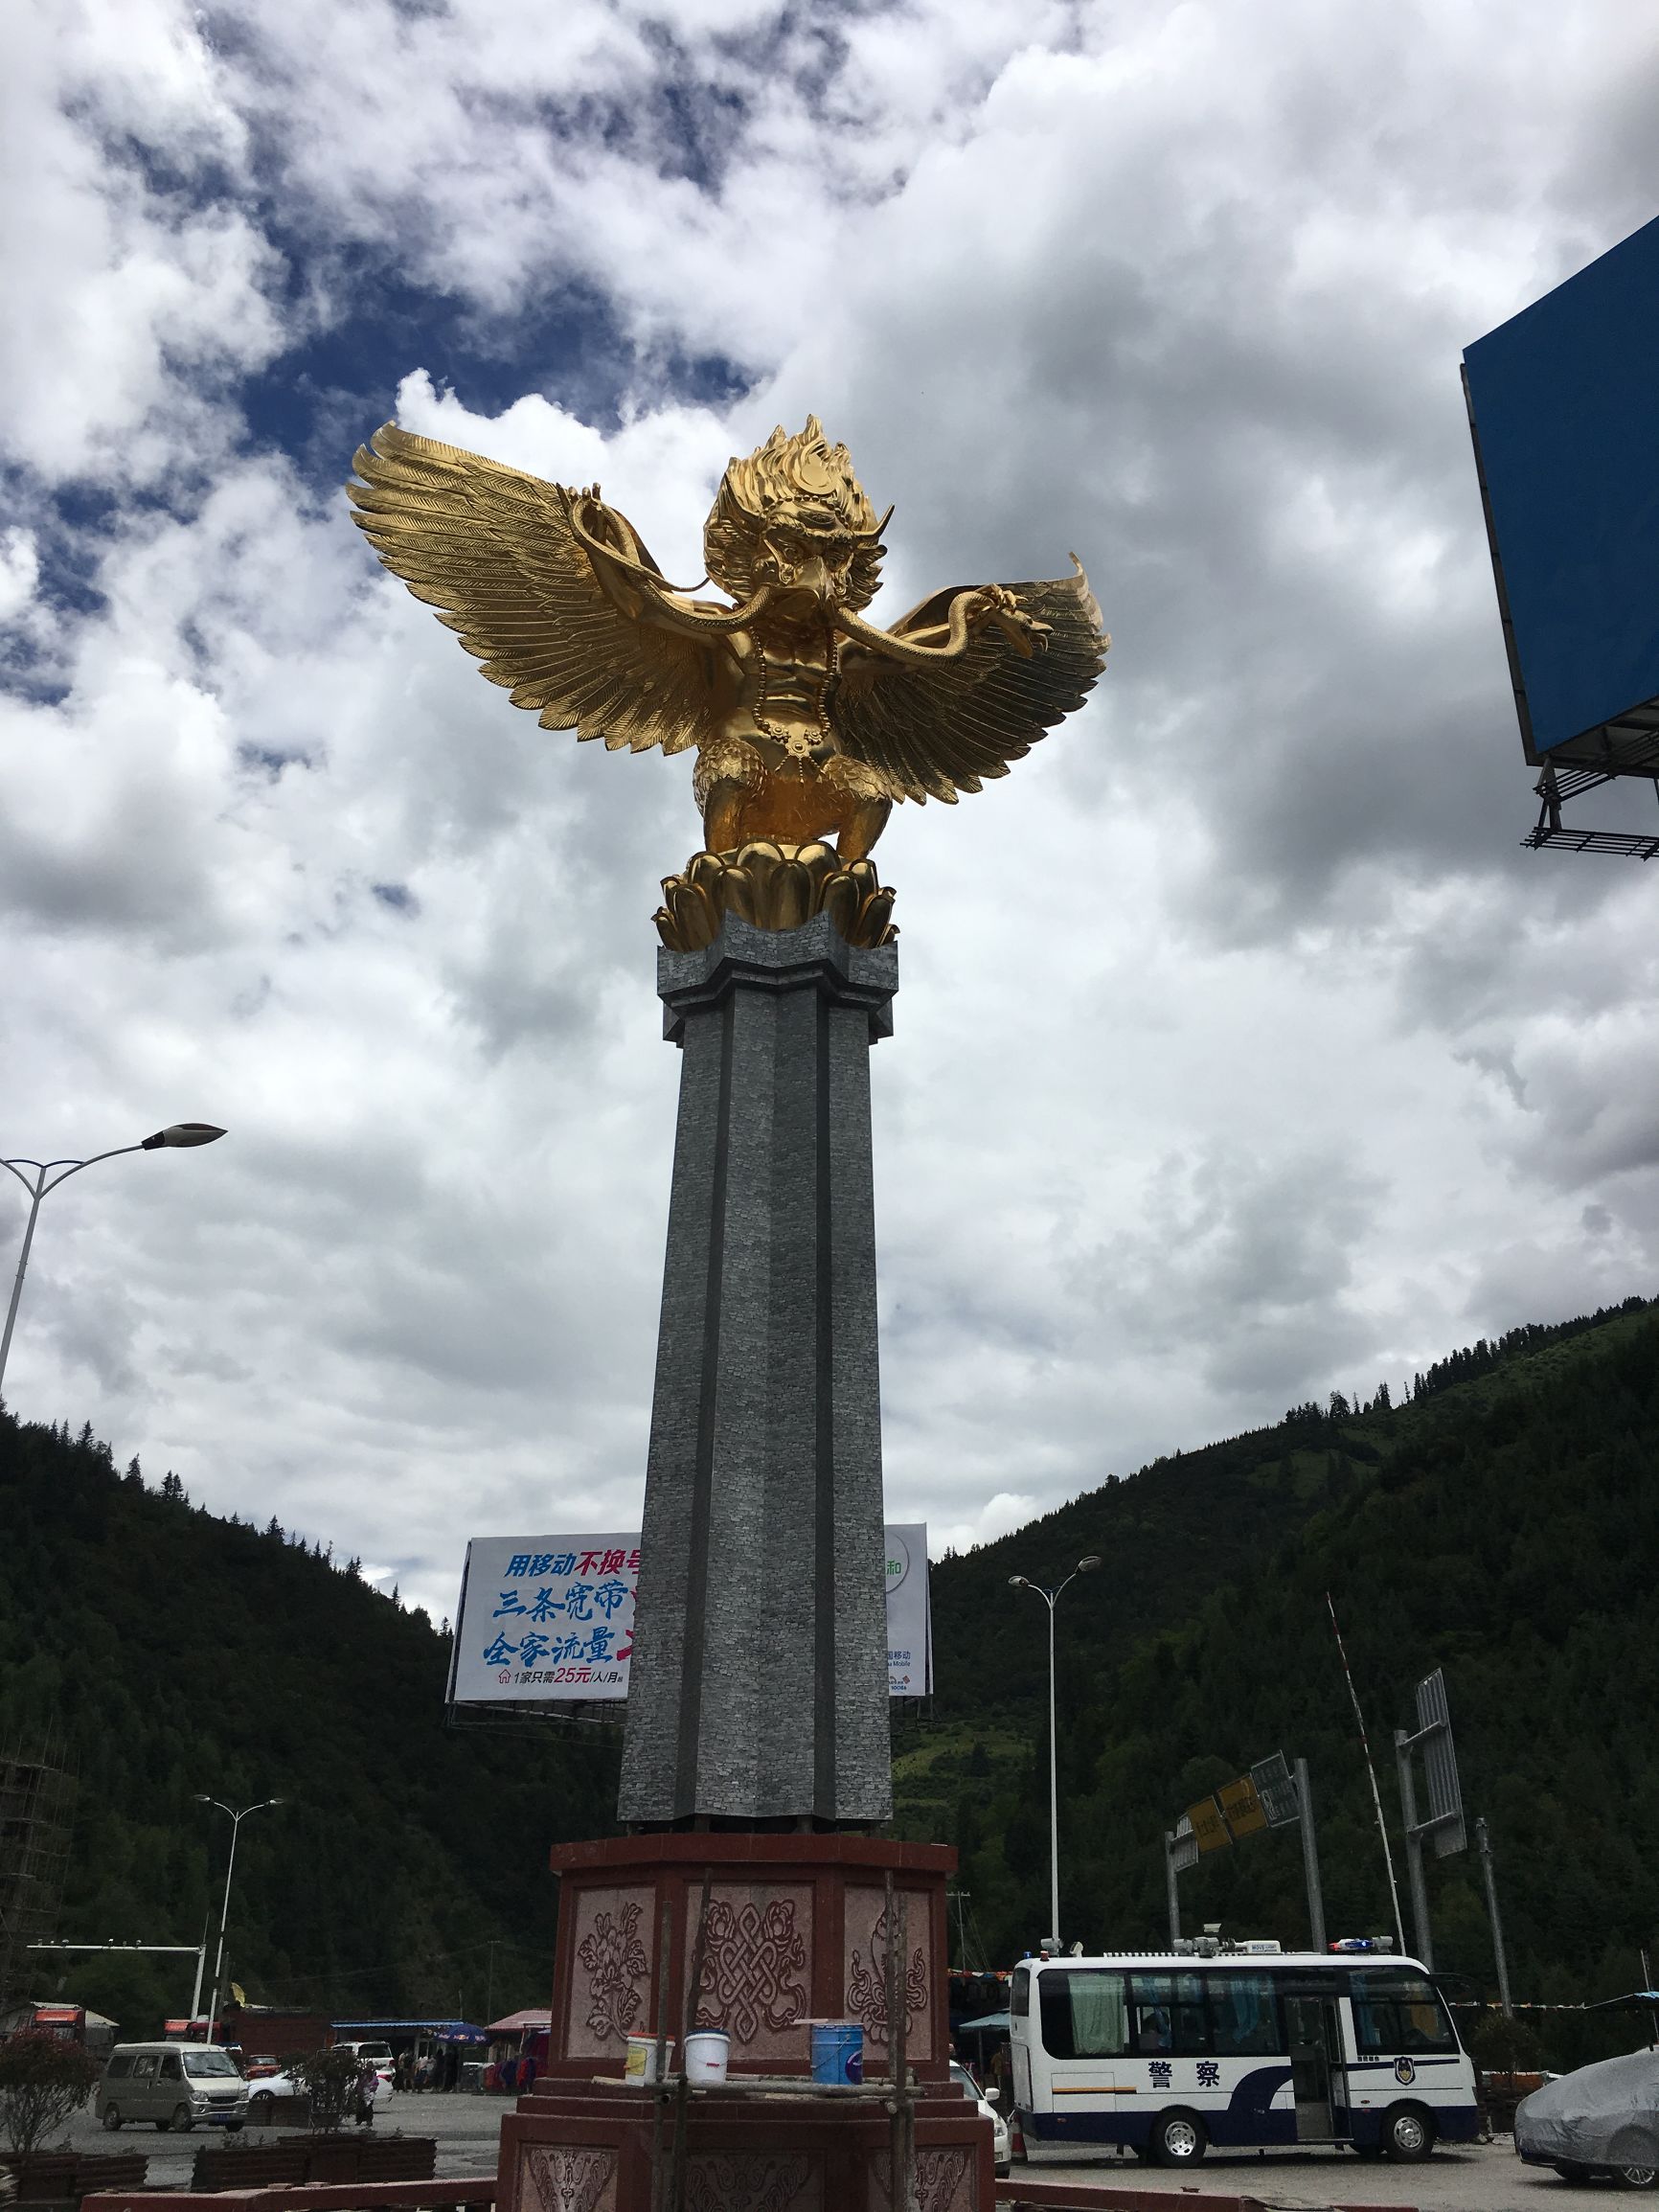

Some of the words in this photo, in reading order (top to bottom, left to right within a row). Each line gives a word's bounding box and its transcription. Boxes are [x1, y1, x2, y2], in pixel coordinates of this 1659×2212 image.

[887, 1560, 902, 1576] 和
[492, 1579, 638, 1623] 三条宽带
[1148, 2060, 1220, 2088] 警察
